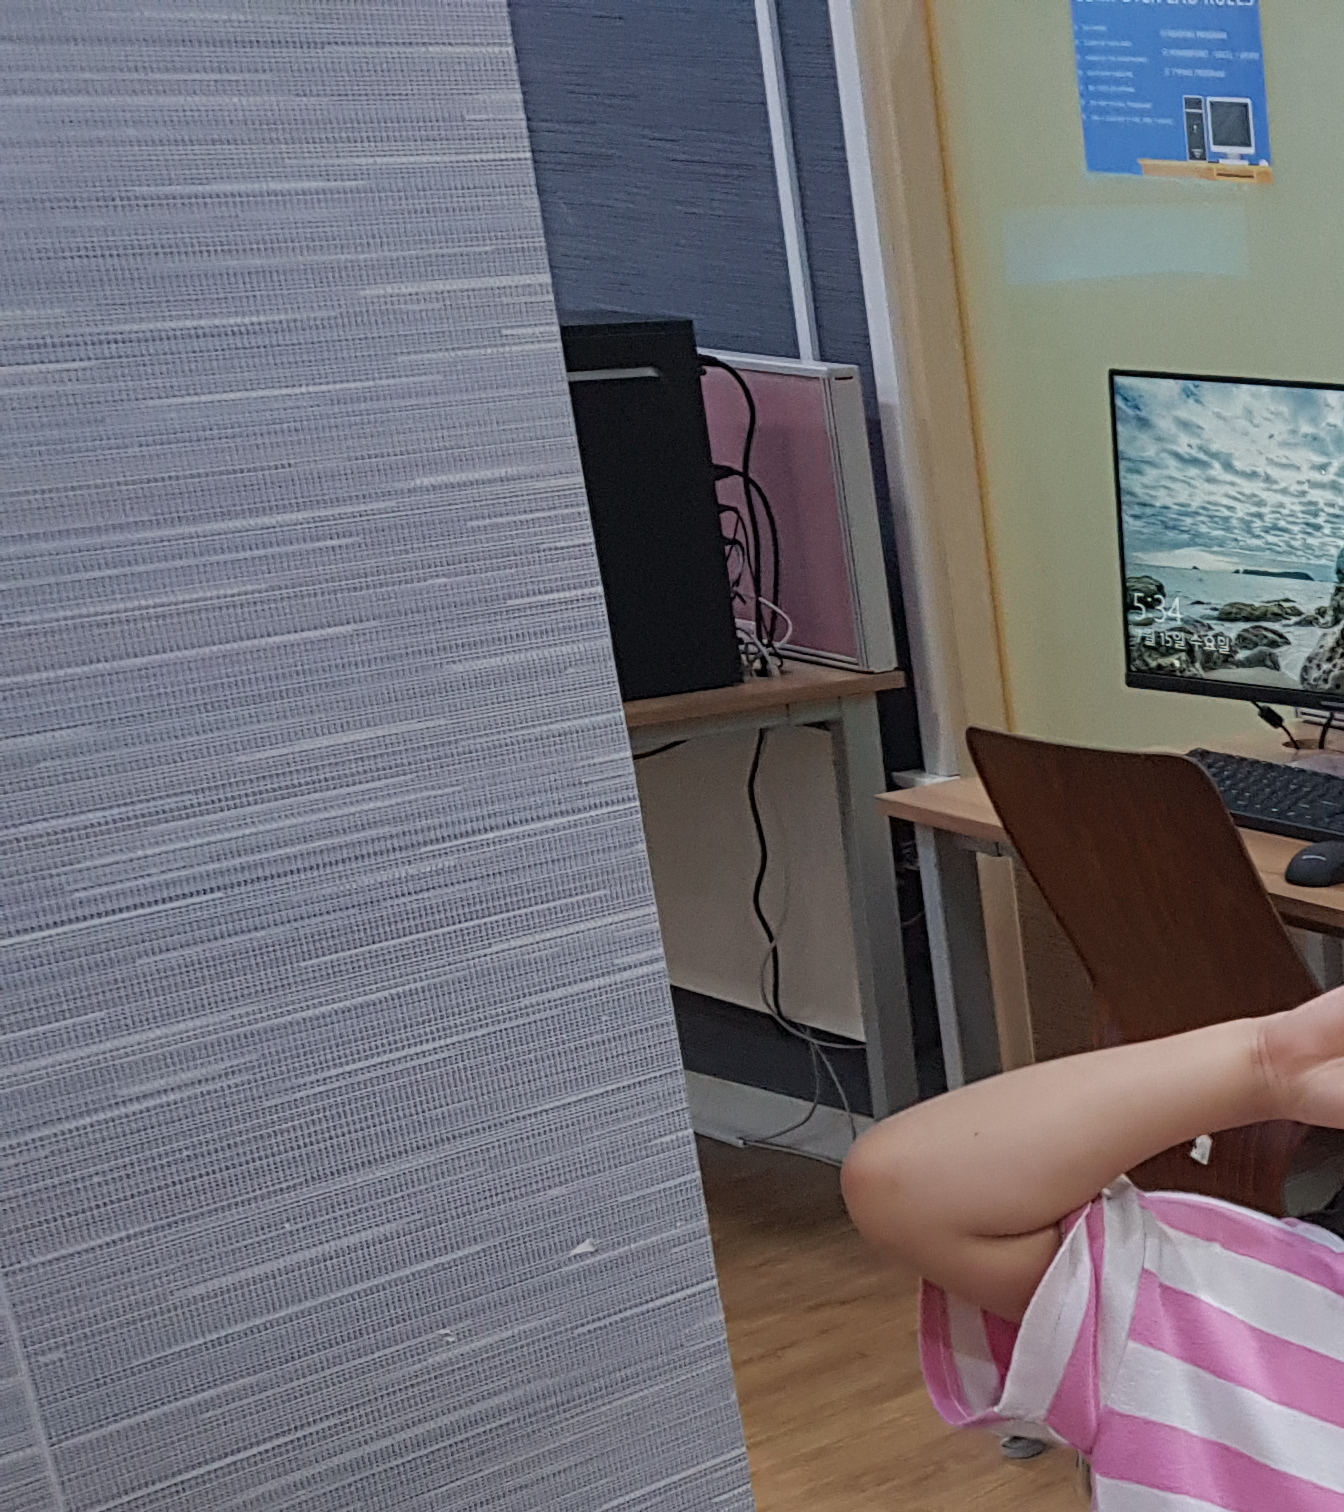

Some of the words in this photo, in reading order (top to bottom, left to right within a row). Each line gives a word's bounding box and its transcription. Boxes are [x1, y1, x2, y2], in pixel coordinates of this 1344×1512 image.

[1133, 592, 1181, 624] 5:34
[1160, 631, 1185, 649] 15일
[1190, 633, 1231, 655] 수요일
